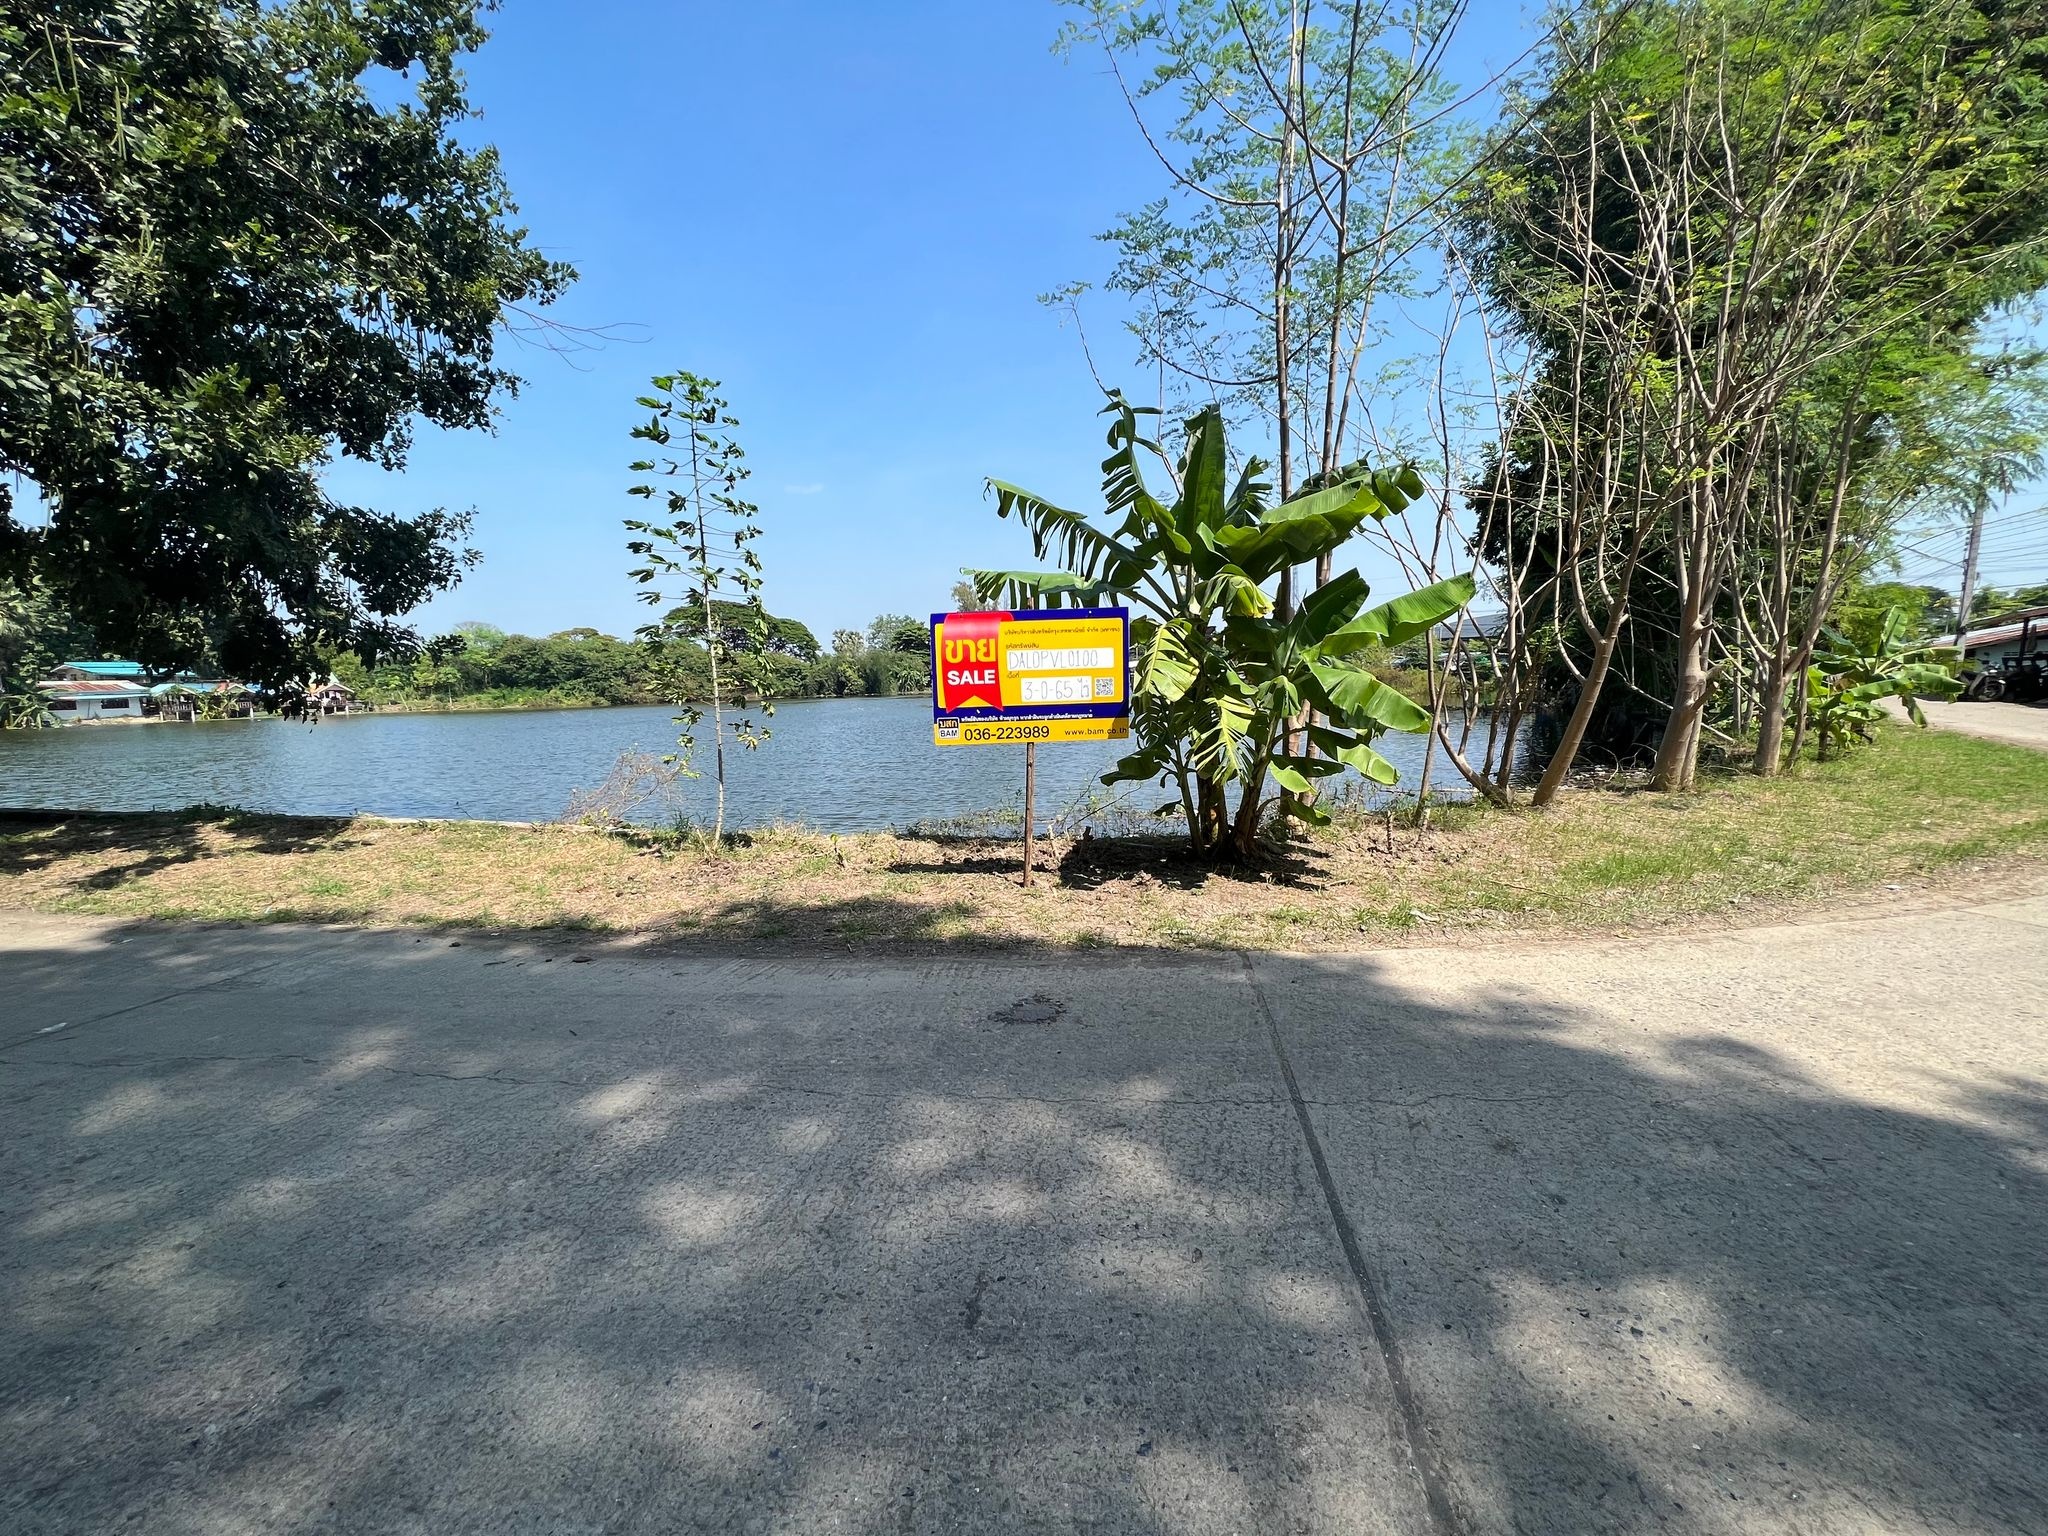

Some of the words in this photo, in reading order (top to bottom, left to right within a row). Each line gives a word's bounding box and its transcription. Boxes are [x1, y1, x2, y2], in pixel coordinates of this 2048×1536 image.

[945, 638, 996, 664] ขาย
[947, 669, 996, 686] SALE
[940, 729, 958, 738] BAM
[964, 725, 1050, 741] 036-223989
[1064, 727, 1127, 736] www.bam.co.th
